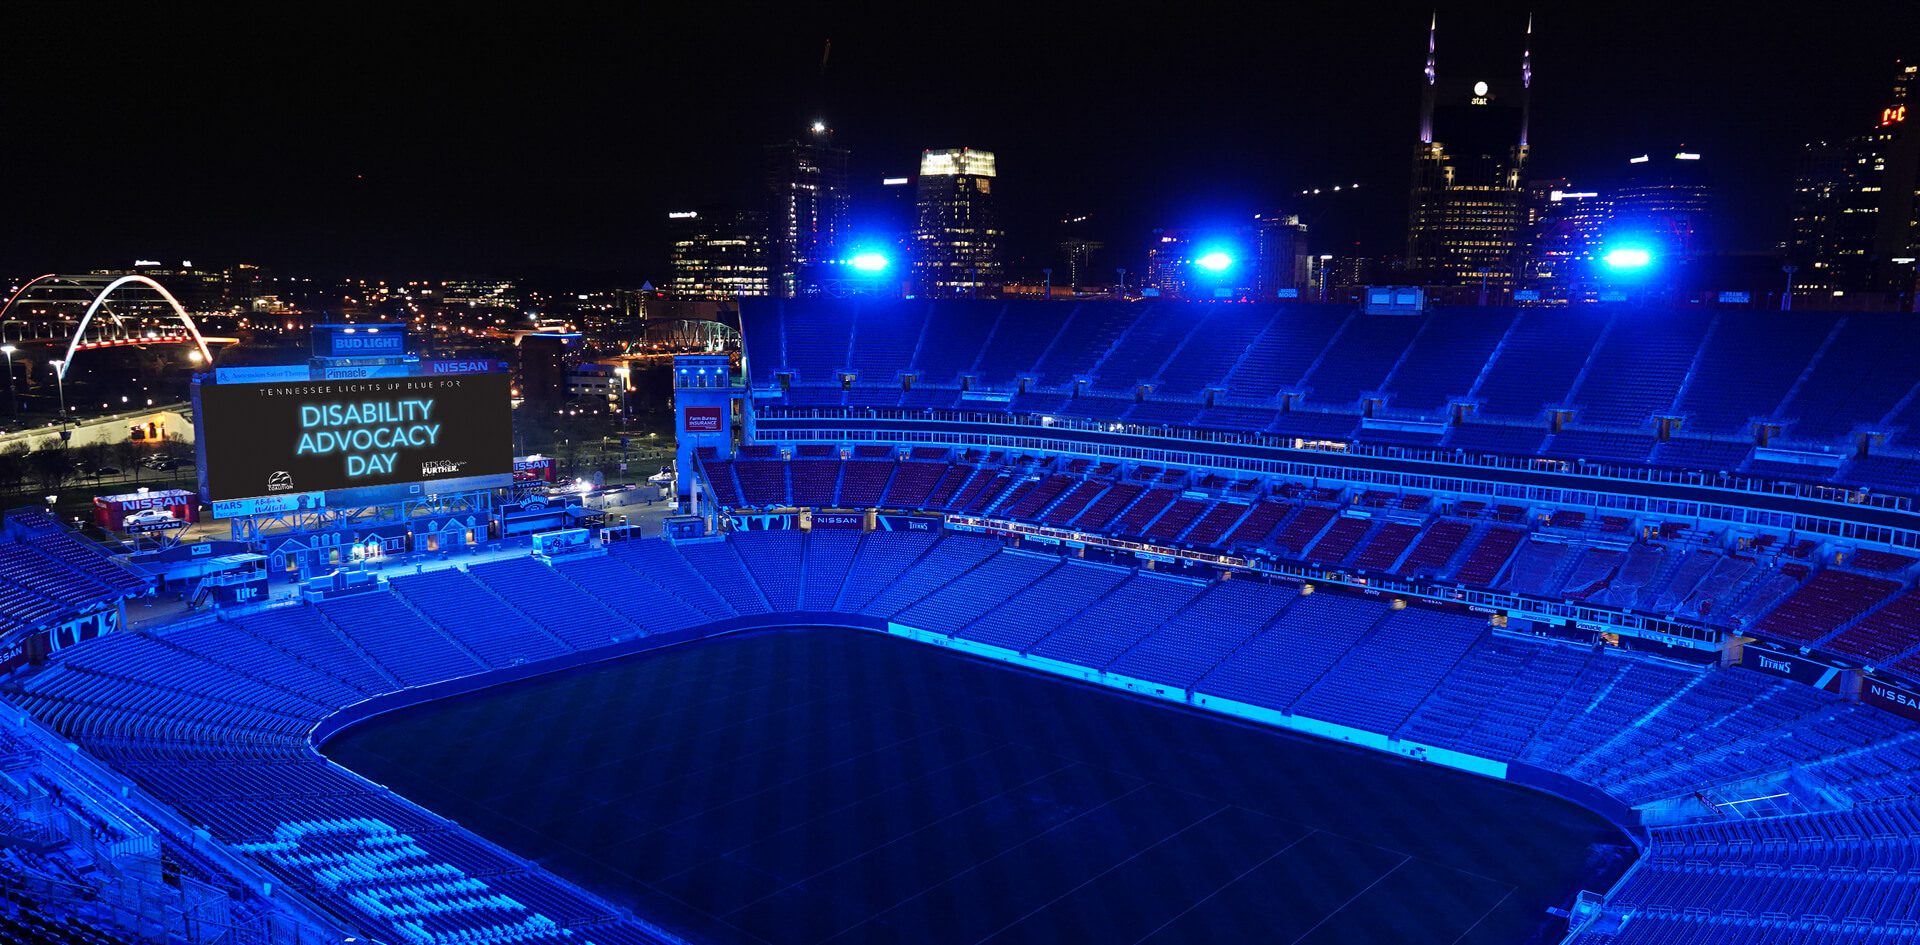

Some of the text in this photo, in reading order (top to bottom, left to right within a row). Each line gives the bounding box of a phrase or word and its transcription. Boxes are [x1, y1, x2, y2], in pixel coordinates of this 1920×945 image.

[335, 337, 400, 350] BUD LIGHT
[327, 369, 367, 378] Pinnacle
[433, 361, 488, 373] NISSAN
[259, 385, 332, 396] TENNESSEE
[338, 384, 382, 393] LIGHTS
[408, 381, 434, 390] BLUE
[440, 380, 461, 388] FOR
[301, 400, 434, 428] DISABILITY
[296, 424, 440, 455] ADVOCACY
[347, 453, 398, 477] DAY
[514, 460, 550, 470] ISSAN
[122, 496, 188, 511] NISSAN
[215, 501, 242, 510] MARS
[142, 521, 182, 532] TITAN
[908, 521, 928, 530] TITANS
[236, 586, 258, 603] Lite
[1758, 655, 1792, 674] TITANS
[1871, 685, 1920, 710] NISSA
